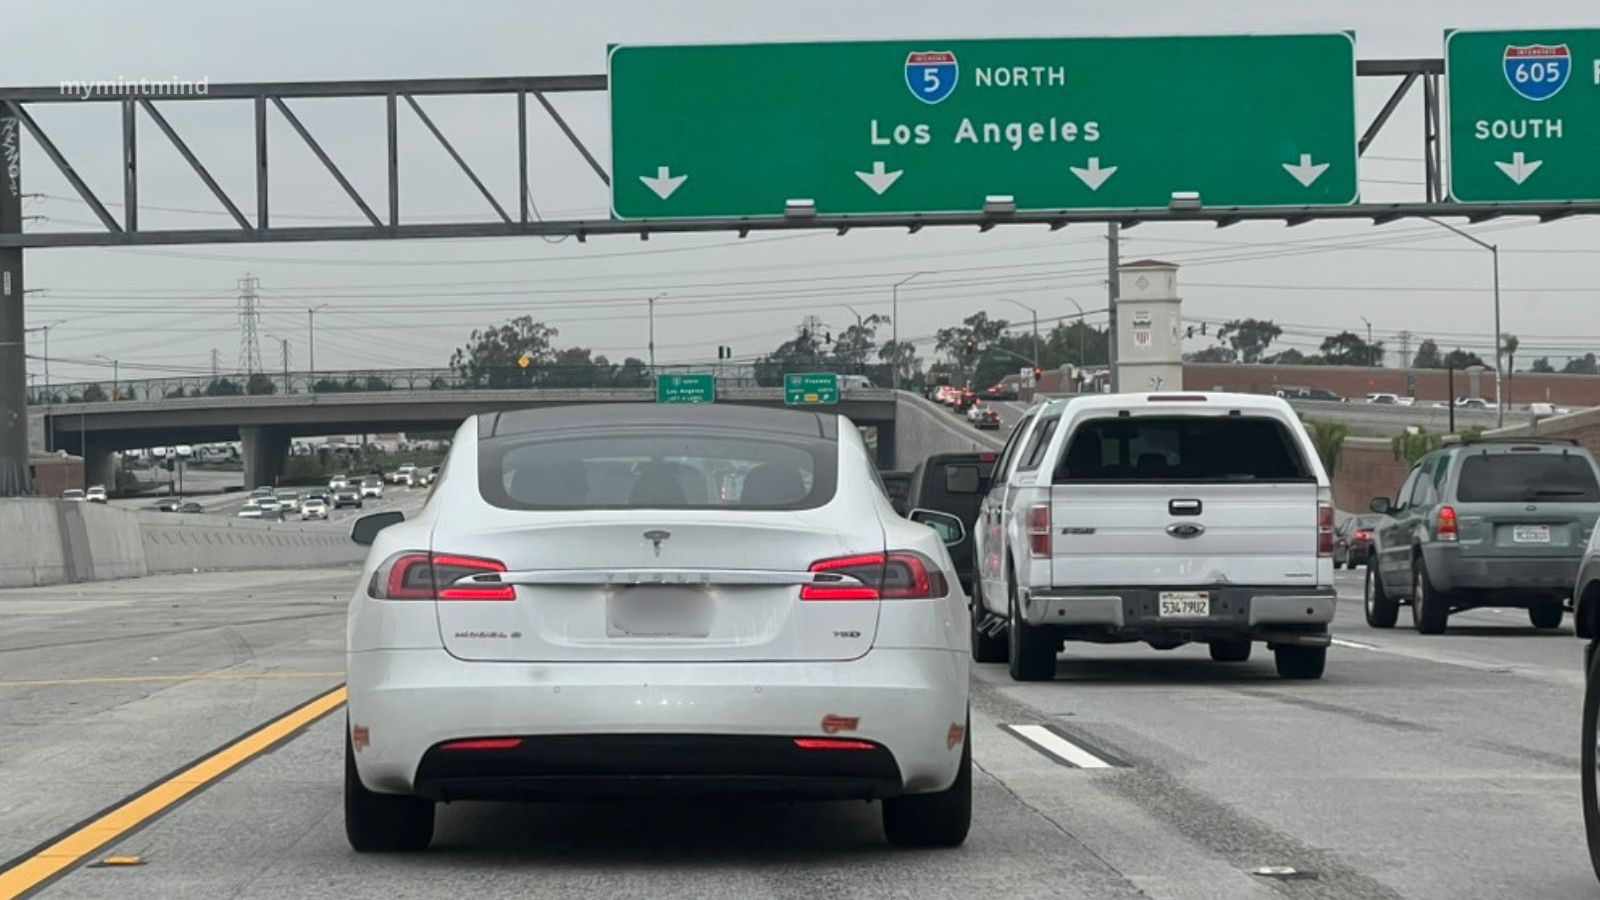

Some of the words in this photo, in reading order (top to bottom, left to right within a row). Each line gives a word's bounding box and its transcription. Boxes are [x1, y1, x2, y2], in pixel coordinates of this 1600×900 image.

[923, 68, 940, 92] 5
[975, 66, 1065, 87] NORTH
[1515, 62, 1560, 83] 605
[871, 119, 931, 145] Los
[954, 117, 1100, 151] Angeles
[1475, 118, 1563, 139] SOUTH
